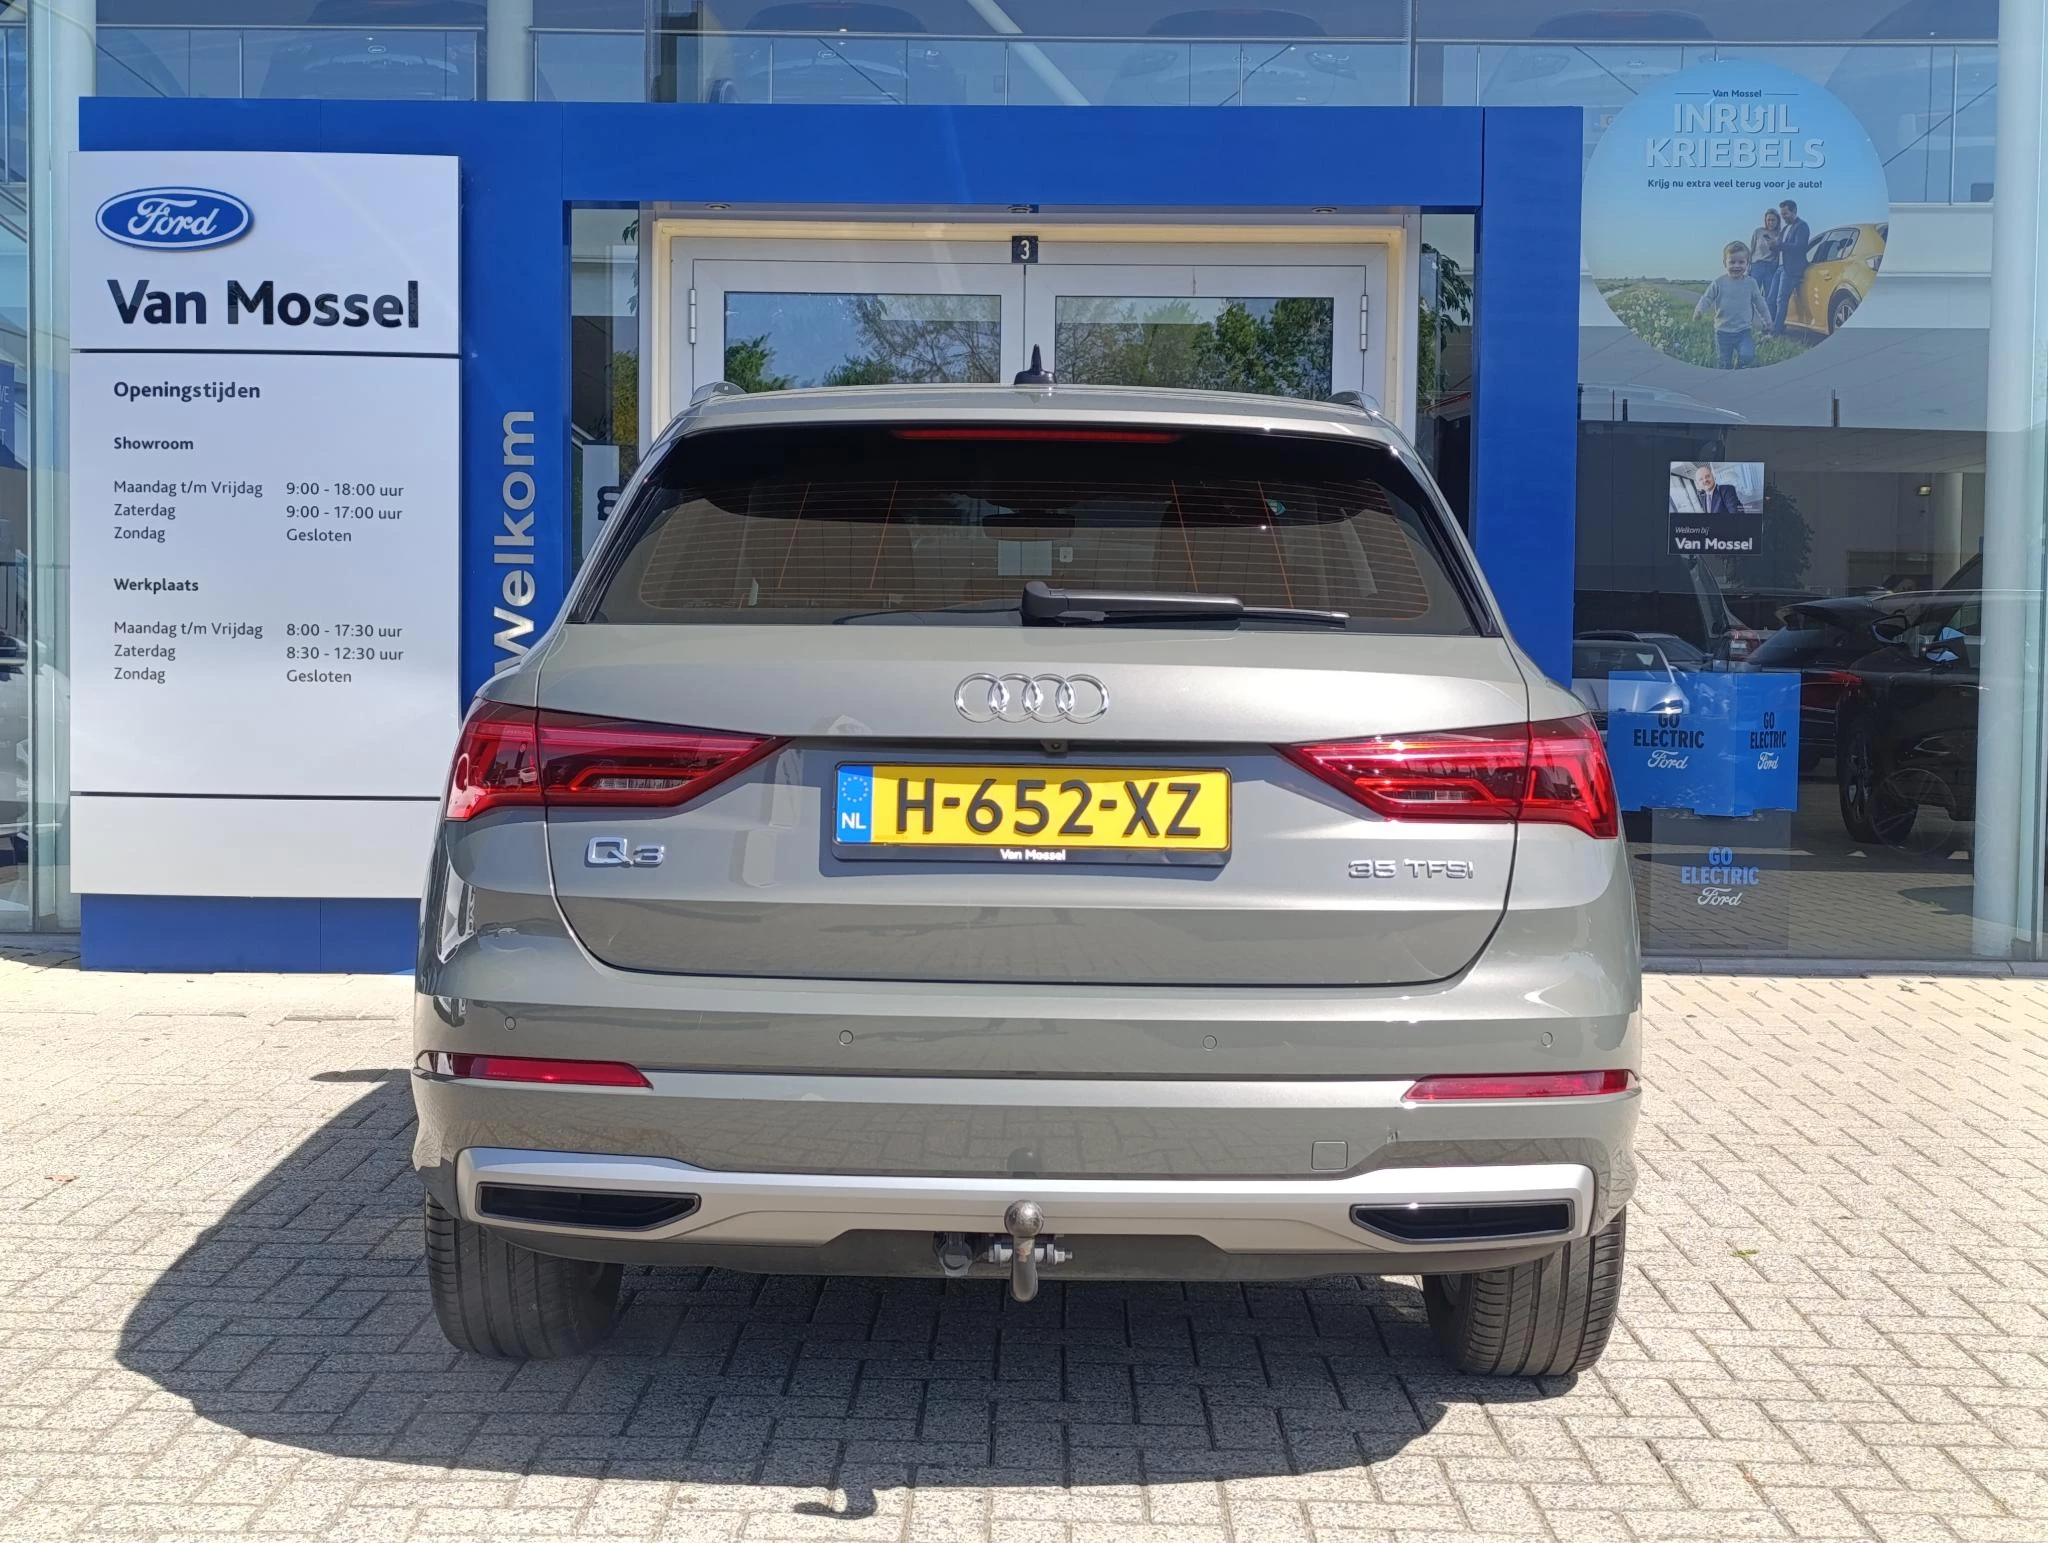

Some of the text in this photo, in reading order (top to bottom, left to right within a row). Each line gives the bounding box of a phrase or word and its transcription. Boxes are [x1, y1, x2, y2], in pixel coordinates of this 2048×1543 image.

[1712, 89, 1762, 98] Van Mossel
[1673, 103, 1800, 134] INRUIL
[1647, 137, 1826, 169] KRIEBELS
[1648, 178, 1823, 190] Krijg nu extra veel terug voor je auto!
[127, 197, 220, 236] Ford
[1020, 239, 1030, 260] 3
[107, 279, 419, 329] Van Mossel
[113, 381, 261, 403] Openingstijden
[113, 436, 194, 450] Showroom
[114, 480, 177, 498] Maandag
[180, 480, 207, 494] t/m
[211, 481, 263, 499] Vrijdag
[286, 482, 320, 496] 9:00
[334, 482, 376, 496] 18:00
[379, 486, 404, 497] uur
[113, 503, 176, 521] Zaterdag
[286, 505, 320, 519] 9:00
[334, 505, 374, 520] 17:00
[378, 510, 403, 520] uur
[113, 526, 352, 544] Zondag Gesloten
[494, 411, 536, 675] Welkom
[1675, 537, 1753, 551] Van Mossel
[113, 577, 199, 595] Werkplaats
[114, 620, 177, 639] Maandag
[180, 620, 207, 635] t/m
[211, 622, 264, 640] Vrijdag
[286, 623, 320, 637] 8:00
[334, 623, 374, 638] 17:30
[378, 627, 403, 638] uur
[113, 643, 176, 662] Zaterdag
[286, 646, 320, 660] 8:30
[334, 646, 375, 661] 12:30
[379, 650, 404, 661] uur
[113, 666, 352, 685] Zondag Gesloten
[1763, 711, 1775, 730] GO
[1633, 729, 1705, 749] ELECTRIC
[1750, 730, 1787, 750] ELECTRIC
[1647, 749, 1689, 770] Ford
[1757, 751, 1779, 770] Ford
[897, 777, 1202, 838] H-652-XZ
[841, 812, 867, 830] NL
[585, 836, 665, 867] Q3
[1000, 848, 1066, 861] Van Mossel
[1708, 846, 1733, 865] GO
[1348, 858, 1474, 879] 35 TFSI
[1680, 866, 1760, 885] ELECTRIC
[1697, 887, 1743, 906] Ford
